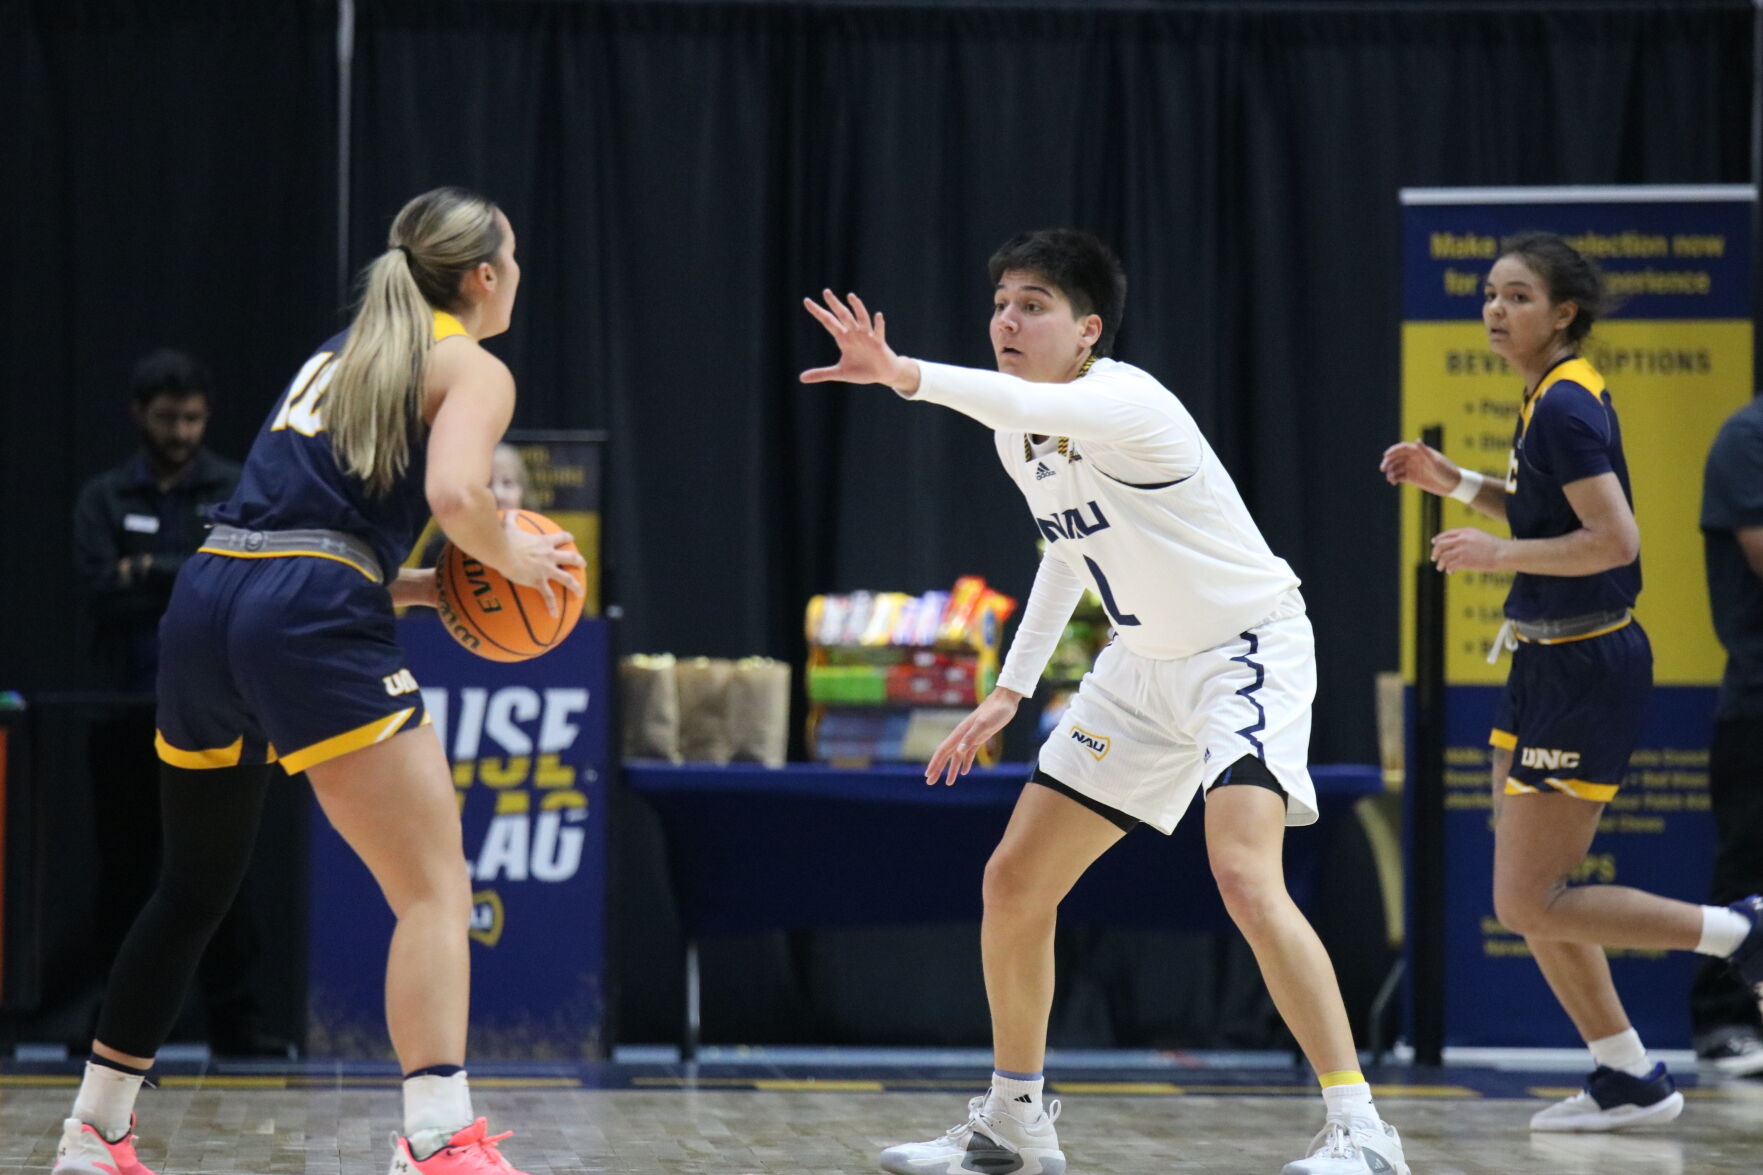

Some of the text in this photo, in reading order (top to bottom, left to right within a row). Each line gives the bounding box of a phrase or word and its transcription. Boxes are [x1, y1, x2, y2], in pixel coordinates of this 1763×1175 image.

[1446, 351, 1712, 376] BEVE OPTIONS
[1036, 500, 1110, 543] NAU
[382, 668, 419, 697] UN
[1072, 731, 1105, 752] NAU
[1521, 747, 1580, 770] UNC
